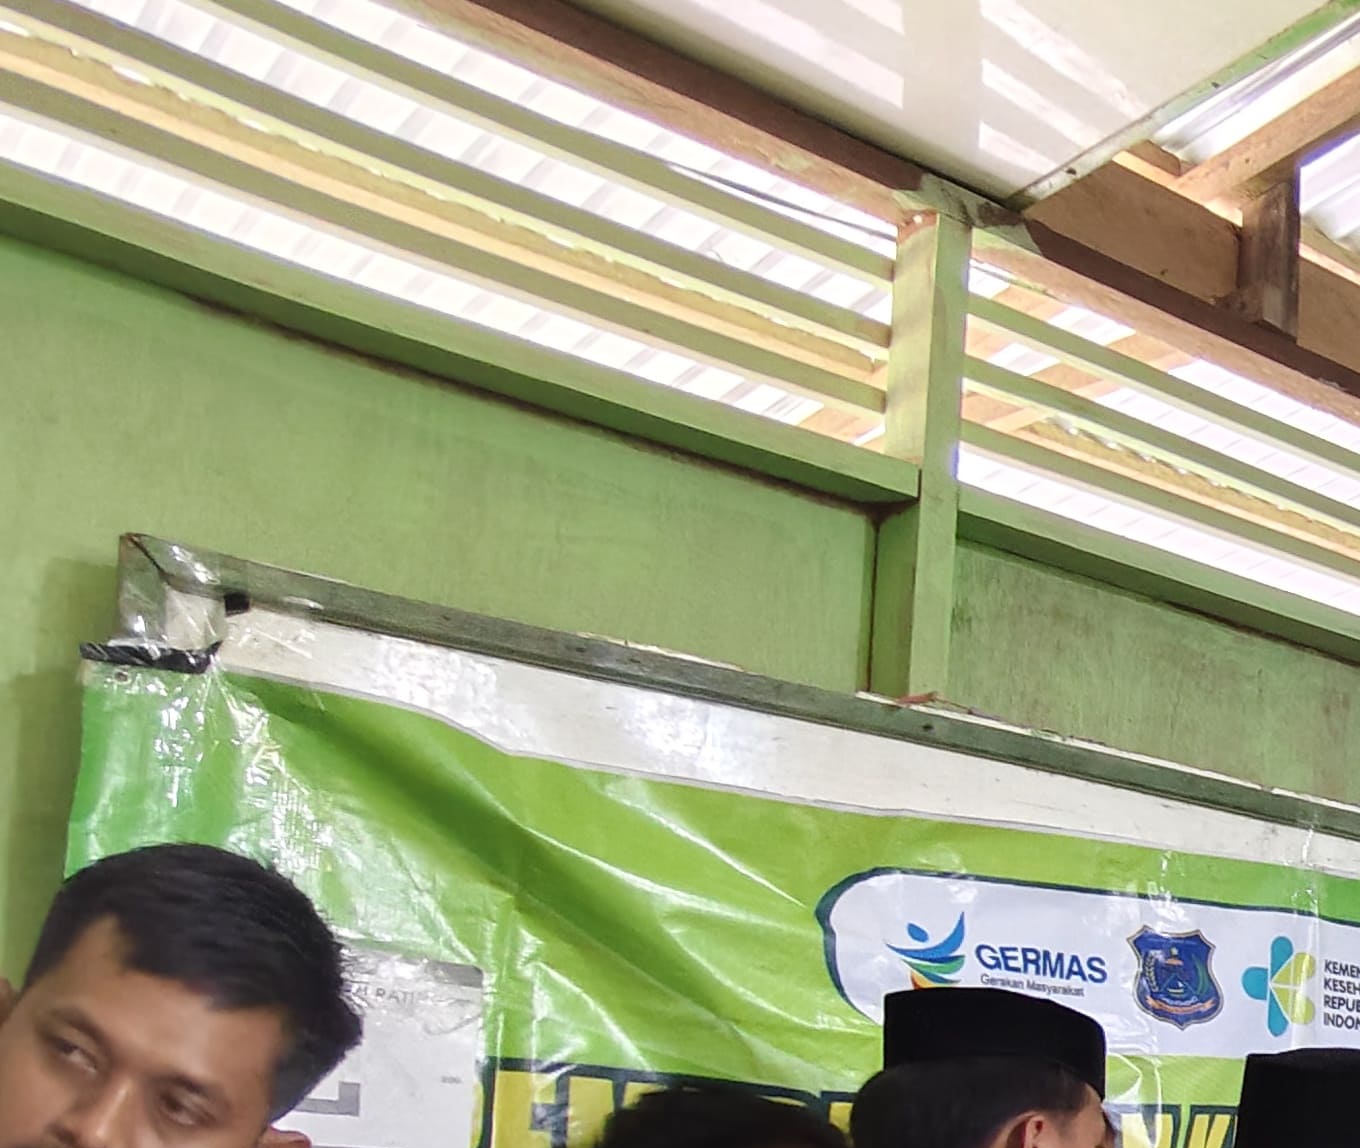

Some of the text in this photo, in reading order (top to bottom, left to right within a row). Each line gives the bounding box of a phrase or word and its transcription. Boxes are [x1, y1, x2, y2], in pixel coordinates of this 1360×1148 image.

[975, 944, 1108, 984] GERMAS
[980, 973, 1085, 997] Gerakan Masyarakat
